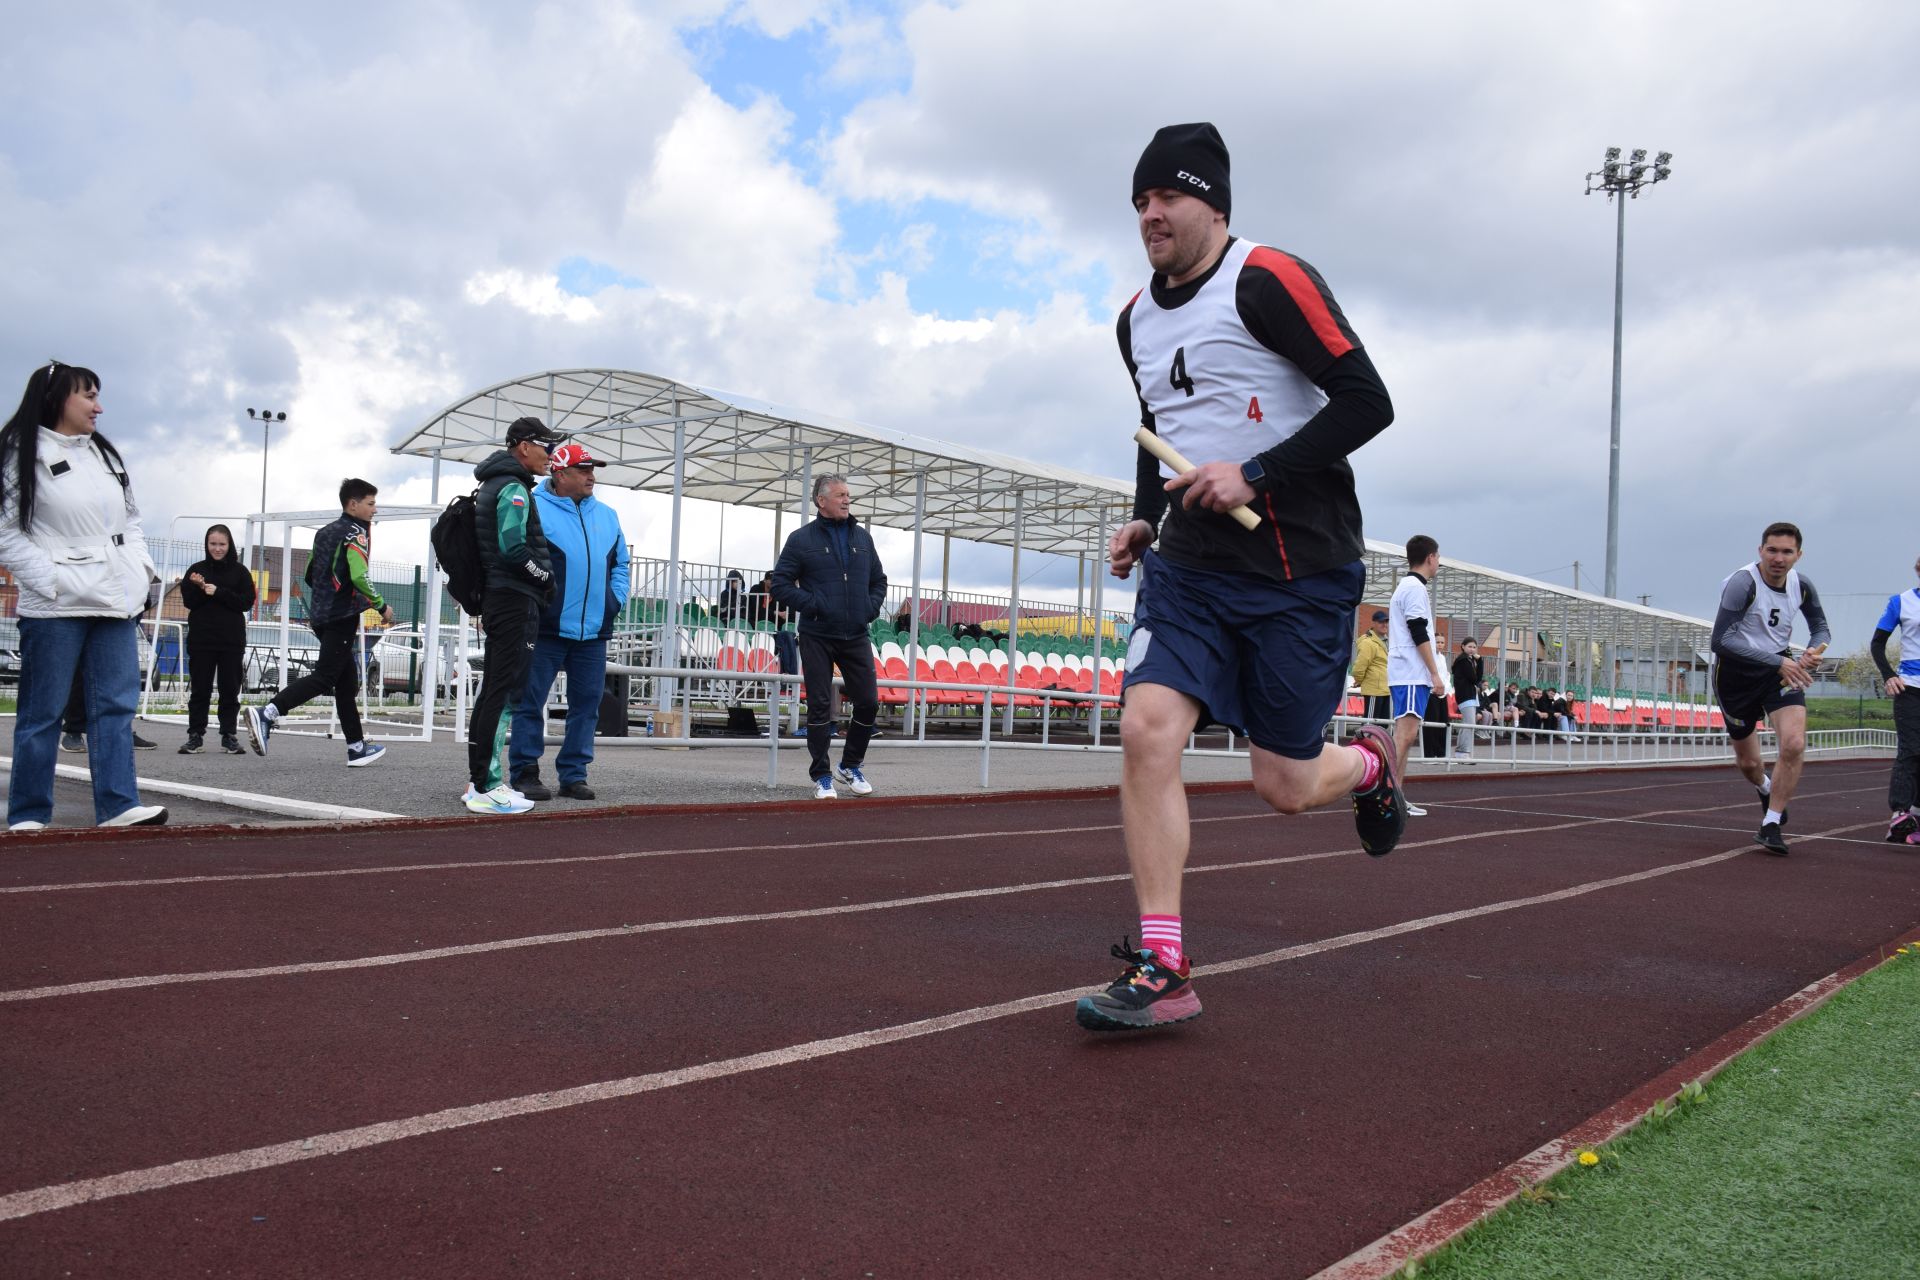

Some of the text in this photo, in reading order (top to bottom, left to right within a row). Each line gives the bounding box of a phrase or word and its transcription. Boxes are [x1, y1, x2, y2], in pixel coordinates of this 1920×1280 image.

[1177, 170, 1211, 191] CCM
[1170, 346, 1194, 397] 4
[1247, 396, 1263, 423] 4
[1767, 608, 1780, 627] 5
